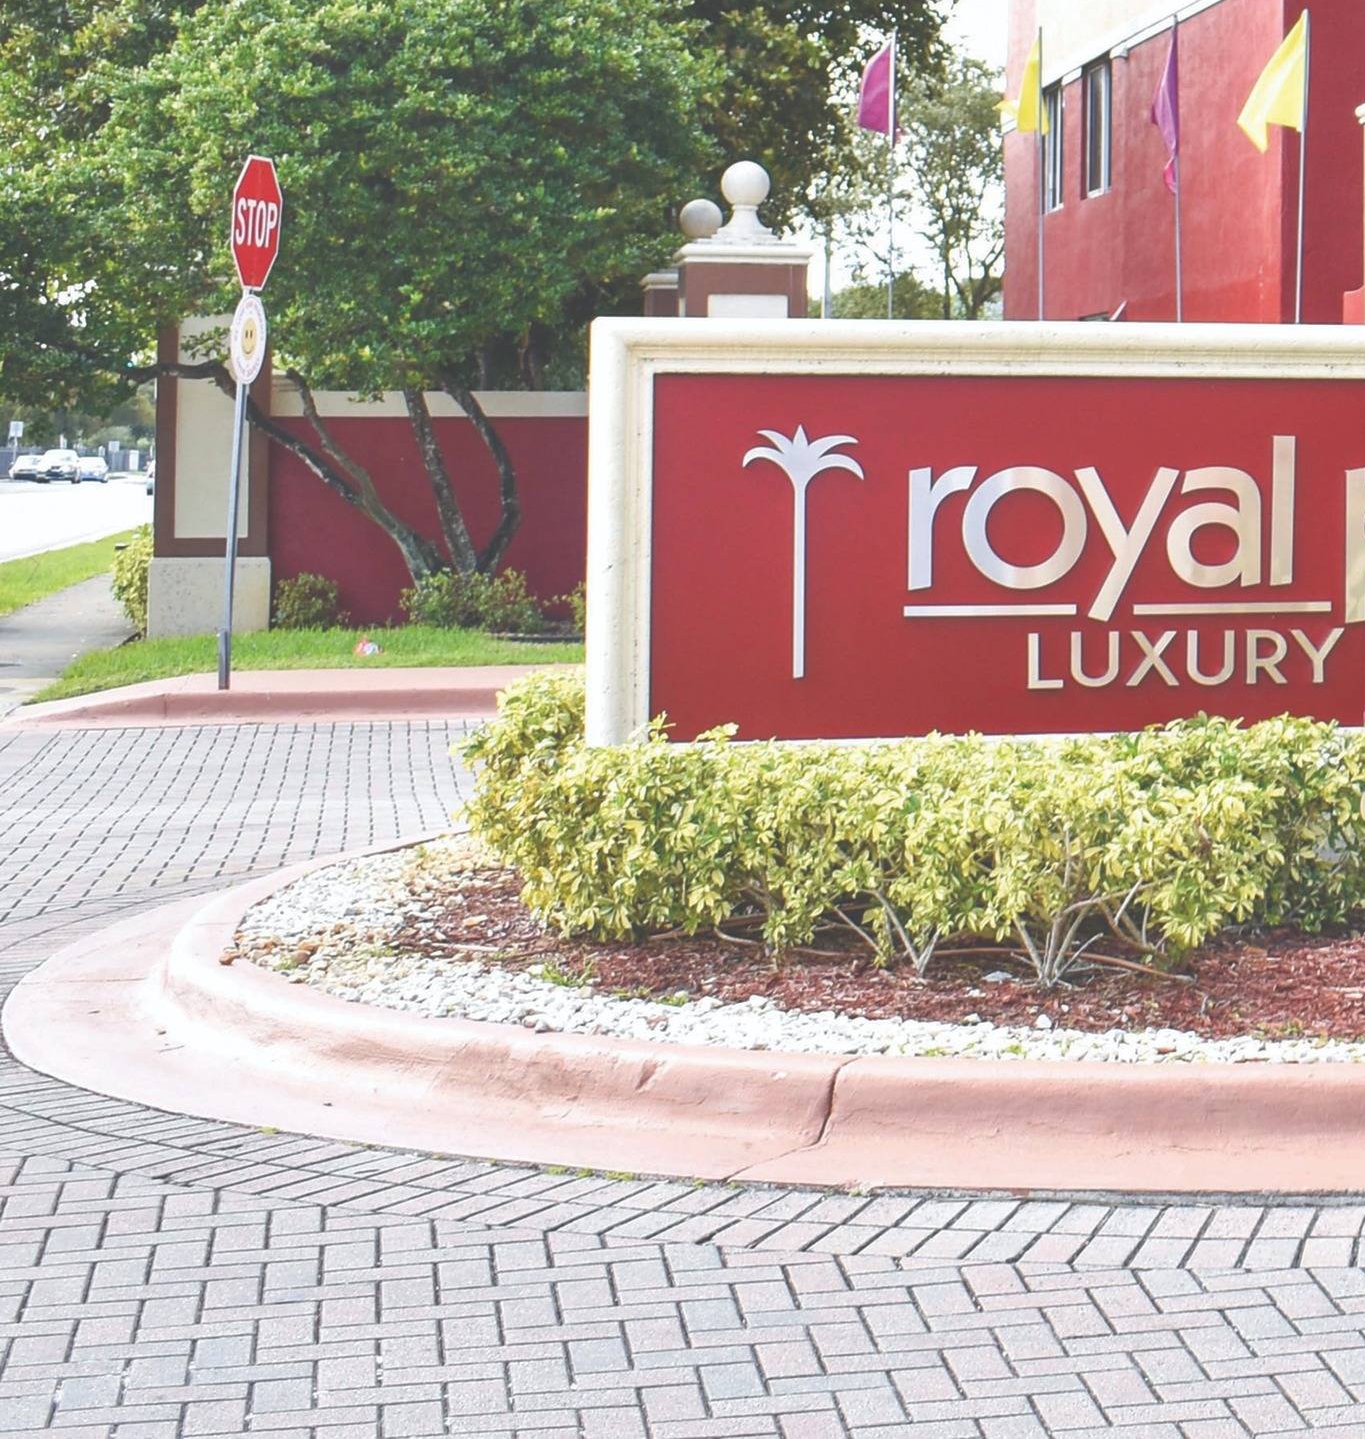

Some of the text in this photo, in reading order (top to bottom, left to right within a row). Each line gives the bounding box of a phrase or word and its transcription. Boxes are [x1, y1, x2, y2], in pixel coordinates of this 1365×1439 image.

[235, 197, 278, 248] STOP
[907, 435, 1296, 622] royal
[1026, 627, 1345, 689] LUXURY
